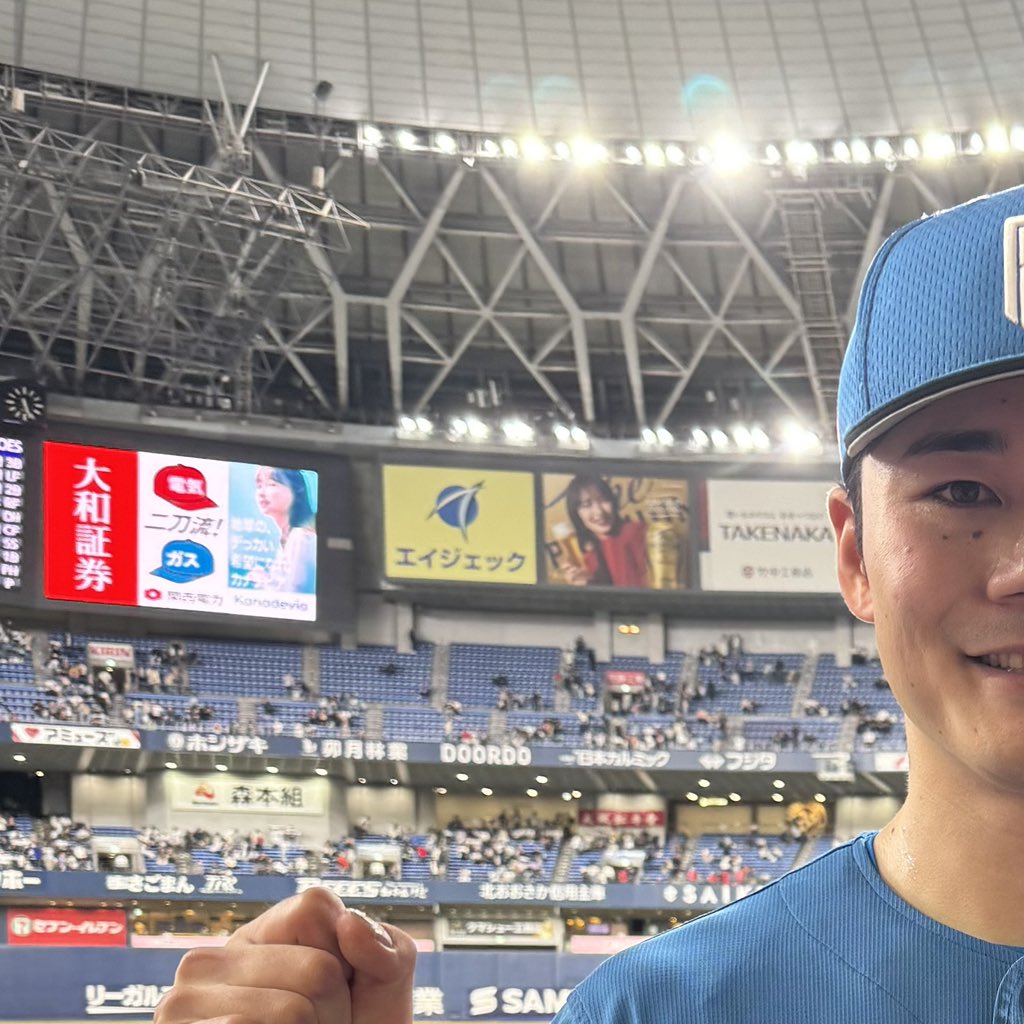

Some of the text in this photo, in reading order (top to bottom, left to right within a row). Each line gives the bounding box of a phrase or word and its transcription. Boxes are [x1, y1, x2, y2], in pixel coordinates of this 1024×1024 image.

[73, 457, 113, 592] 大和証券
[719, 524, 834, 543] TAKENAKA
[166, 550, 201, 569] ガス
[395, 546, 526, 573] エイジェック
[234, 594, 309, 612] Kanadevia
[186, 733, 268, 755] ホシザキ
[725, 751, 778, 772] フジタ
[230, 785, 304, 808] 森本組
